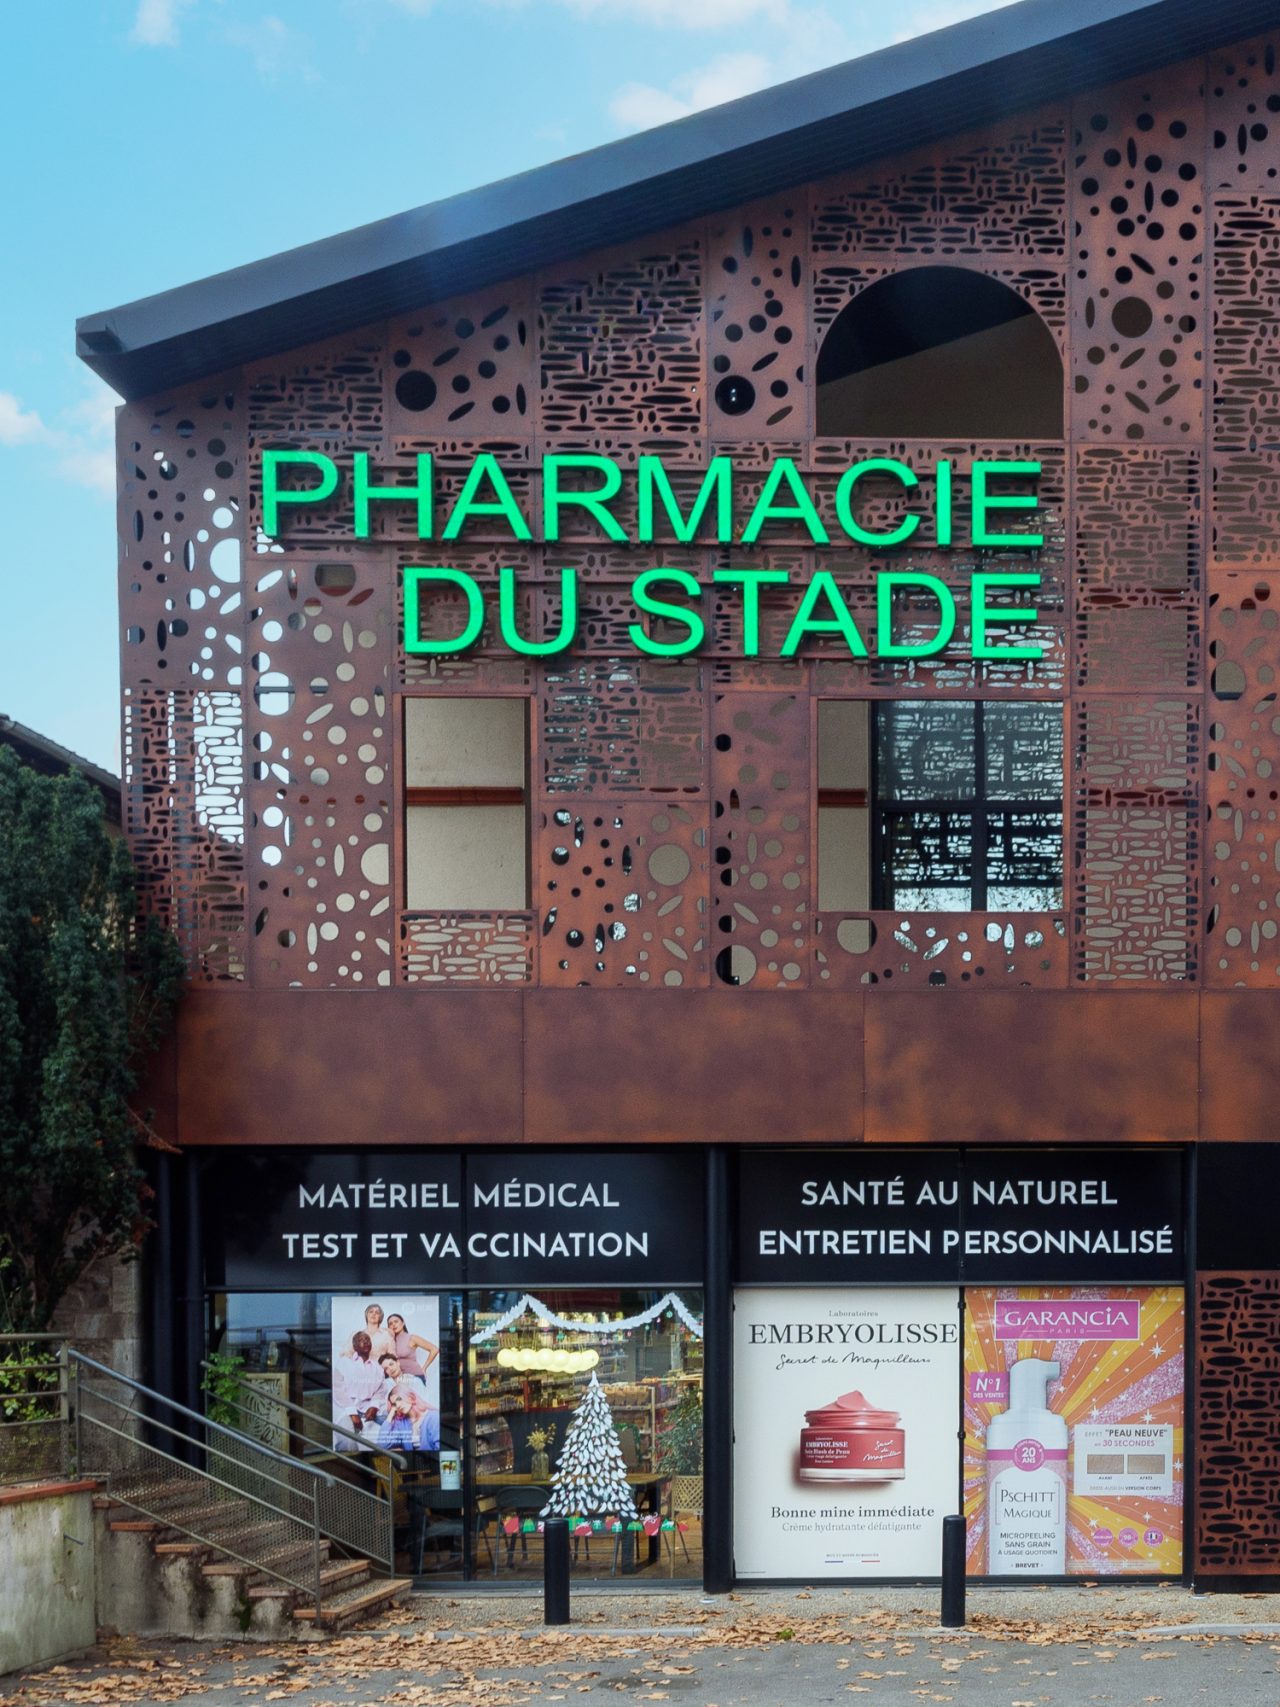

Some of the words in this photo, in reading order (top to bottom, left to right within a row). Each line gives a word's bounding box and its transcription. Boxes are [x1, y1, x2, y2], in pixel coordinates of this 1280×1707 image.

[262, 449, 1044, 548] PHARMACIE
[402, 567, 580, 657] DU
[628, 568, 1045, 660] STADE
[298, 1178, 459, 1209] MATÉRIEL
[473, 1177, 620, 1209] MÉDICAL
[801, 1175, 905, 1207] SANTÉ
[916, 1181, 959, 1206] AU
[972, 1180, 1118, 1206] NATUREL
[282, 1233, 357, 1259] TEST
[371, 1233, 408, 1259] ET
[759, 1230, 931, 1255] ENTRETIEN
[942, 1225, 1173, 1255] PERSONNALISÉ
[748, 1323, 958, 1344] EMBRYOLISSE
[821, 1355, 838, 1364] de
[1022, 1447, 1036, 1458] 20
[771, 1506, 816, 1518] Bonne
[820, 1506, 855, 1518] mine
[858, 1506, 935, 1518] immédiate
[782, 1522, 813, 1532] Crème
[815, 1522, 866, 1533] hydratante
[868, 1522, 922, 1533] défatigante
